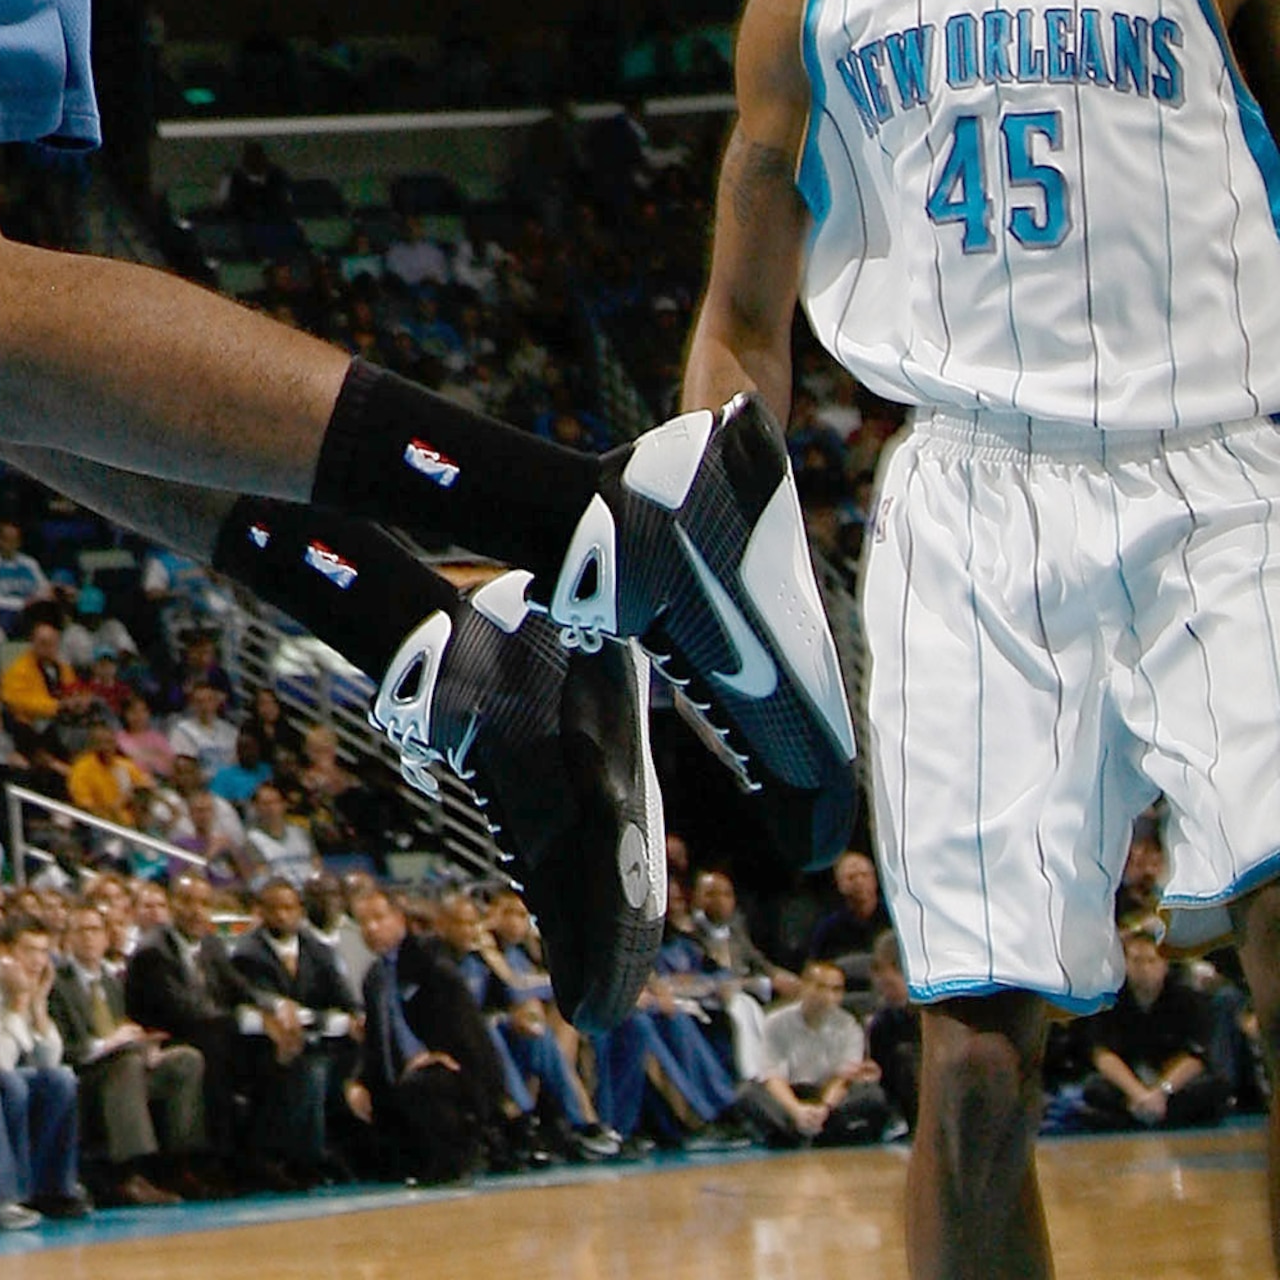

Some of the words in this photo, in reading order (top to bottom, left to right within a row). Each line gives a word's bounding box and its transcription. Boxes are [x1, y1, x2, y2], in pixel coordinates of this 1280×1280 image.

[836, 23, 935, 140] NEW
[945, 8, 1186, 110] ORLEANS
[925, 110, 1073, 256] 45
